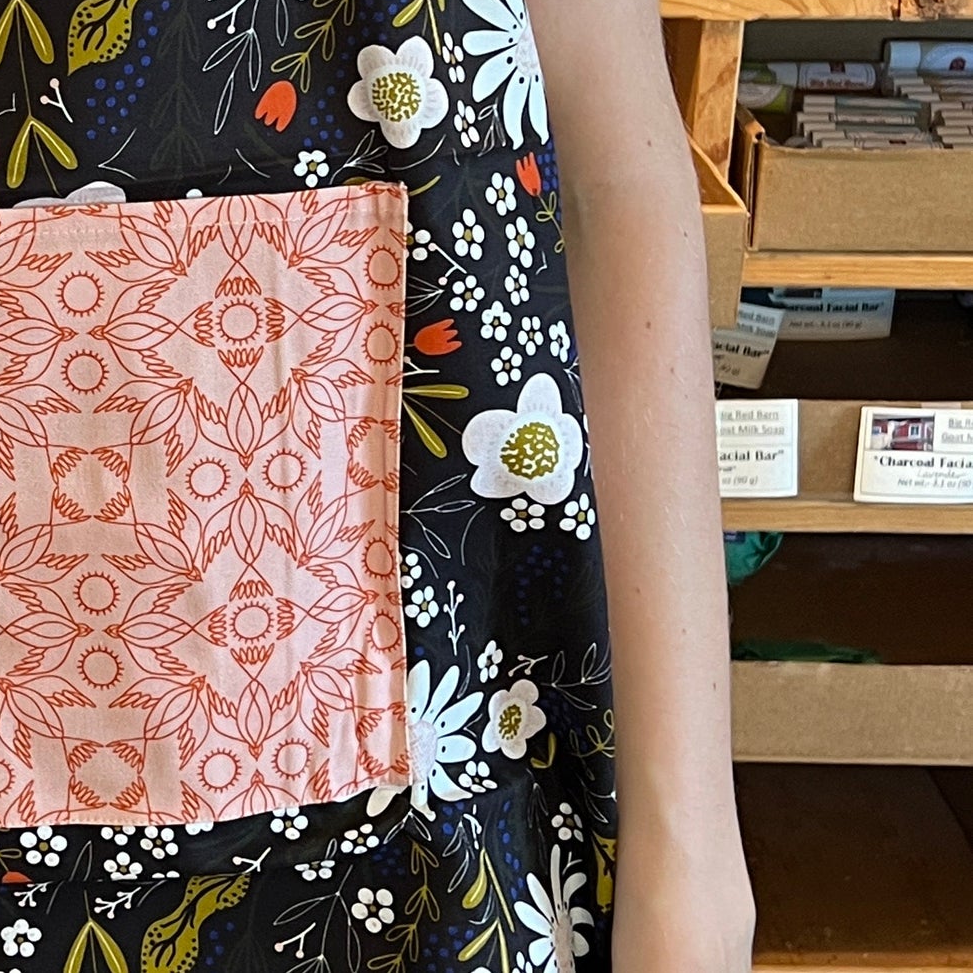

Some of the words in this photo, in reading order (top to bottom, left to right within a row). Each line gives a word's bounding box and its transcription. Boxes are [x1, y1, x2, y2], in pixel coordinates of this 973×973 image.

[827, 302, 858, 311] Facial
[715, 341, 739, 353] acial
[735, 410, 753, 419] Red
[756, 410, 779, 420] Barn
[720, 425, 735, 435] oat
[738, 425, 758, 435] Milk
[762, 425, 784, 435] Soap
[941, 433, 964, 443] Goat
[719, 450, 750, 461] acial
[940, 457, 973, 468] Facia
